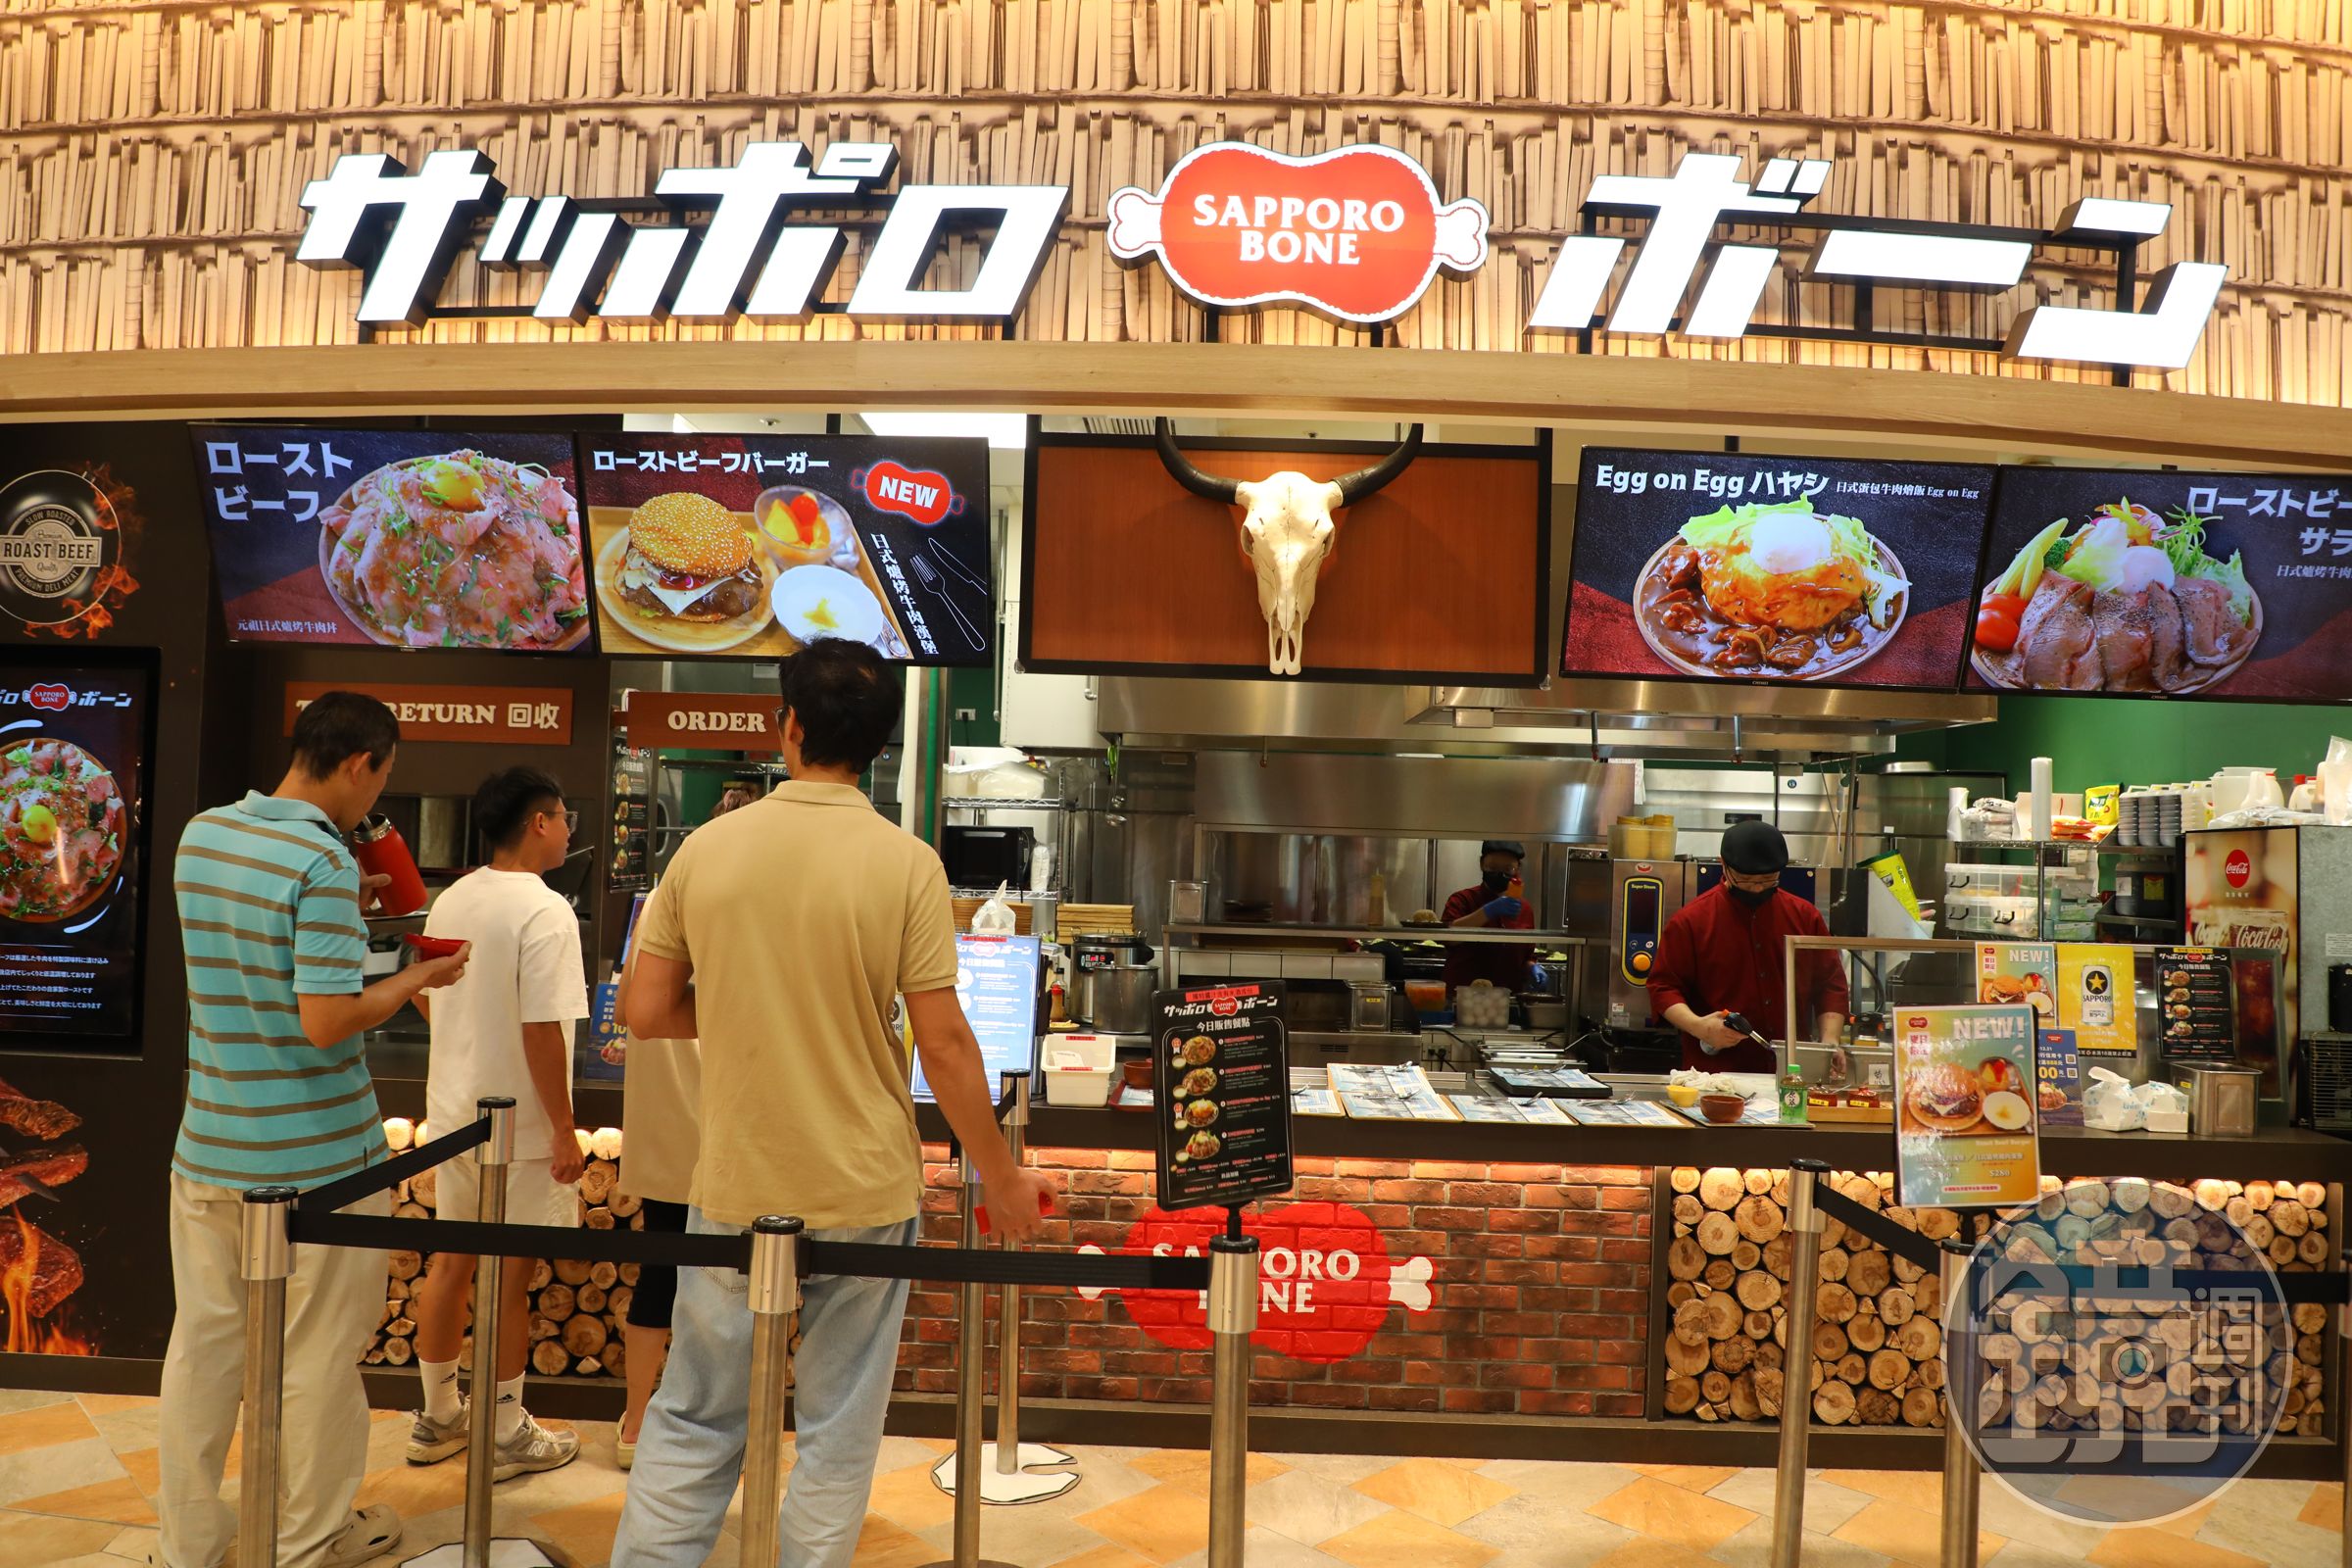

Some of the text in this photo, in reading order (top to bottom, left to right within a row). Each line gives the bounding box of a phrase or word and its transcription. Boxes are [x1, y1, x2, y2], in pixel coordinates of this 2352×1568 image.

[1193, 194, 1405, 232] SAPPORO
[297, 141, 1069, 321] サッポロ
[1239, 229, 1360, 265] BONE
[1528, 153, 2228, 368] ボーン
[206, 441, 353, 478] ロースト
[593, 450, 830, 474] ローストビーフバーガー
[878, 474, 941, 510] NEW
[1595, 465, 1830, 498] Egg on Egg ハヤシ
[1927, 486, 1944, 498] Egg
[1962, 487, 1980, 499] Egg
[214, 484, 319, 523] ビーフ
[4, 542, 94, 559] ROAST BEEF
[78, 691, 132, 707] ボーン
[508, 703, 560, 729] 回收
[667, 710, 766, 732] ORDER
[2009, 950, 2049, 963] NEW!
[1164, 1003, 1205, 1017] サッポロ
[1244, 996, 1278, 1009] ボーン
[1197, 1016, 1250, 1033] 今日販售餐點
[1953, 1016, 2025, 1039] NEW!
